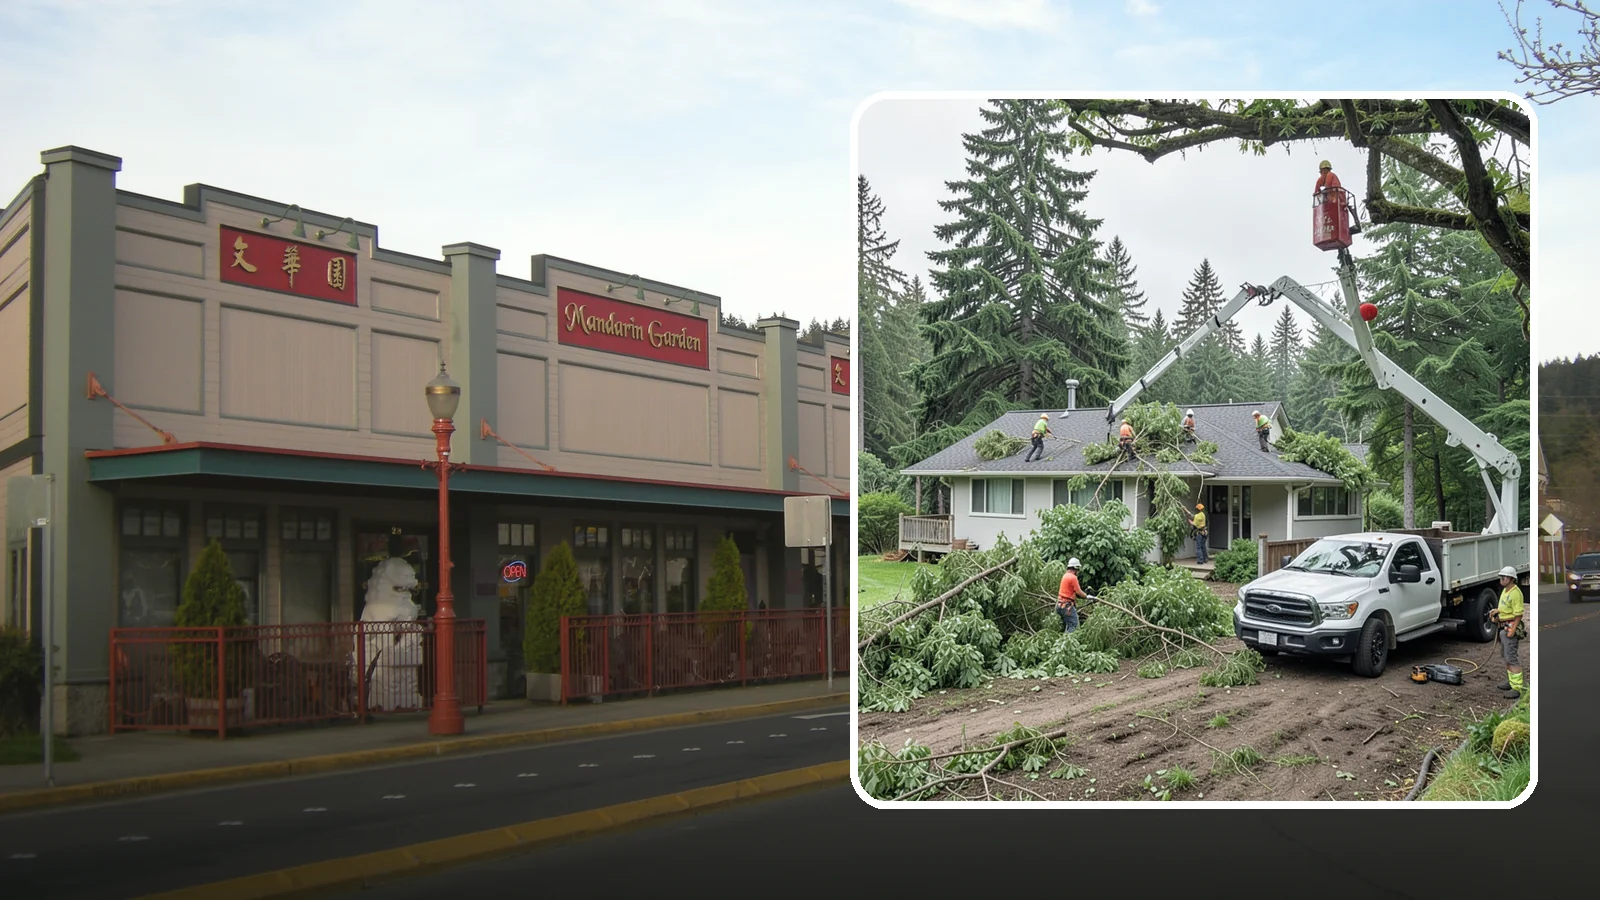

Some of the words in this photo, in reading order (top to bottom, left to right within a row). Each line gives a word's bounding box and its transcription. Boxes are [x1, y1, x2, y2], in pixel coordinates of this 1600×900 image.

[564, 302, 644, 341] Mandarin
[647, 320, 701, 351] Garden
[503, 565, 527, 578] OPEN
